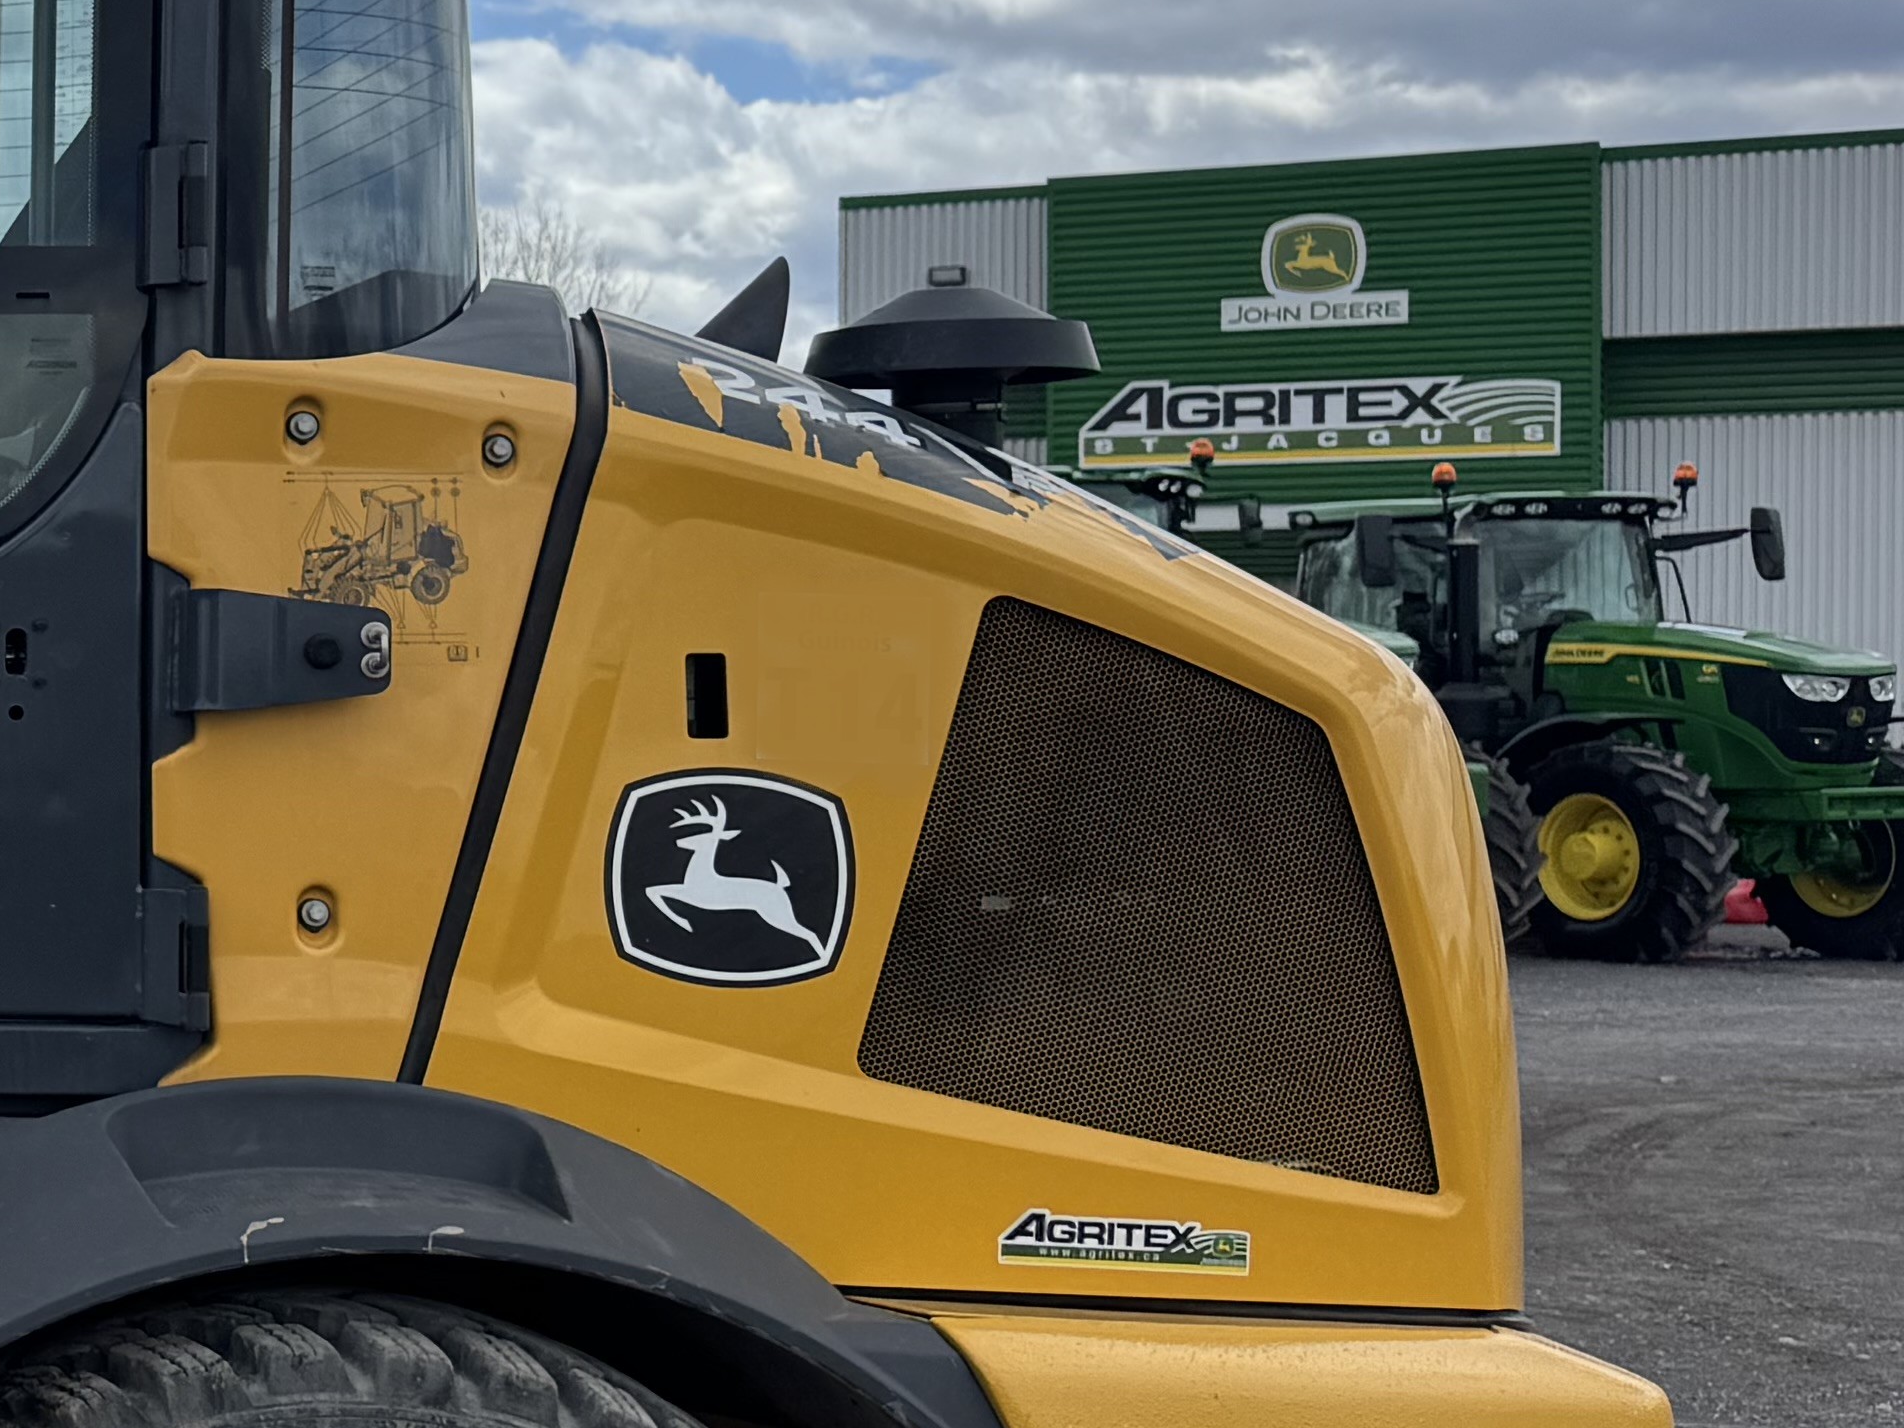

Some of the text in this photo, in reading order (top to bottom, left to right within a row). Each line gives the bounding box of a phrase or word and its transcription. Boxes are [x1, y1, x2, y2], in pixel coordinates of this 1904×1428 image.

[1228, 300, 1402, 325] JOHN DEERE
[692, 357, 921, 447] 244
[1086, 383, 1452, 431] AGRITEX
[1004, 1212, 1198, 1251] AGRITEX
[1038, 1246, 1161, 1263] www.agritex.ca
